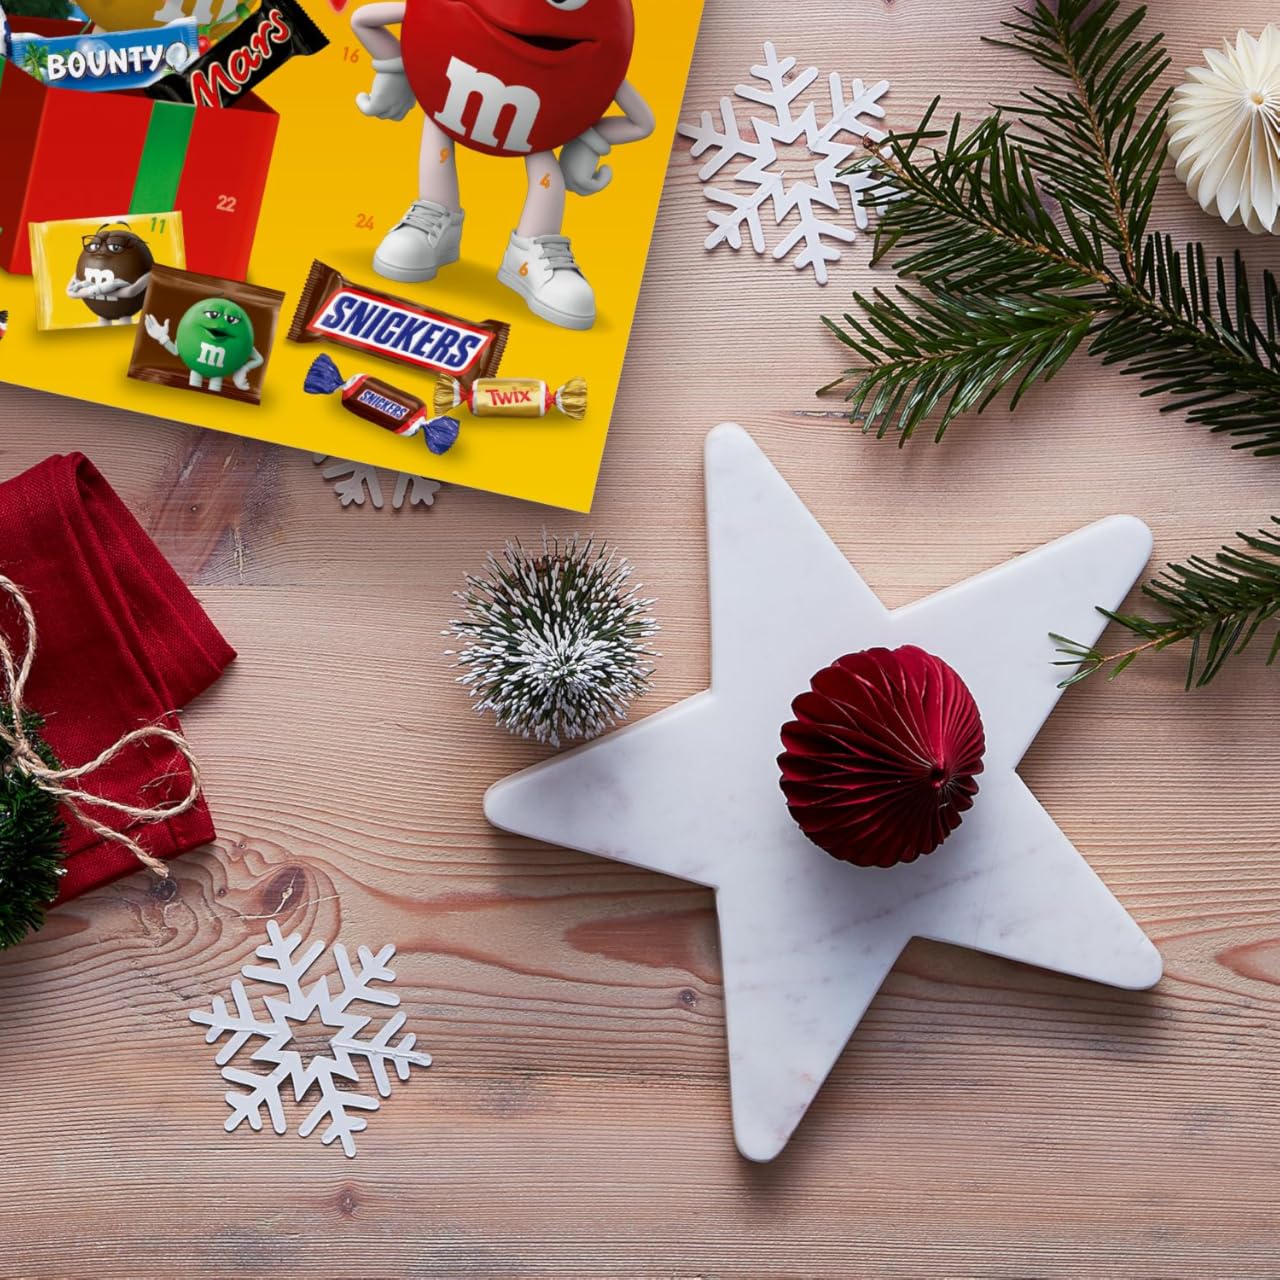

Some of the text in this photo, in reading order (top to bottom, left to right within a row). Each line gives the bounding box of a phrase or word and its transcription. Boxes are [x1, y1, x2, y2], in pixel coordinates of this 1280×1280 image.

[46, 44, 165, 82] BOUNTY
[190, 9, 291, 108] Mars
[342, 46, 360, 64] 16
[433, 55, 541, 153] m
[439, 147, 449, 164] 9
[539, 172, 551, 189] 4
[215, 195, 237, 213] 22
[150, 217, 166, 234] 11
[355, 213, 374, 231] 24
[519, 260, 529, 277] 6
[321, 295, 482, 369] SNICKERS
[196, 341, 227, 368] m
[359, 390, 408, 419] SNICKERS
